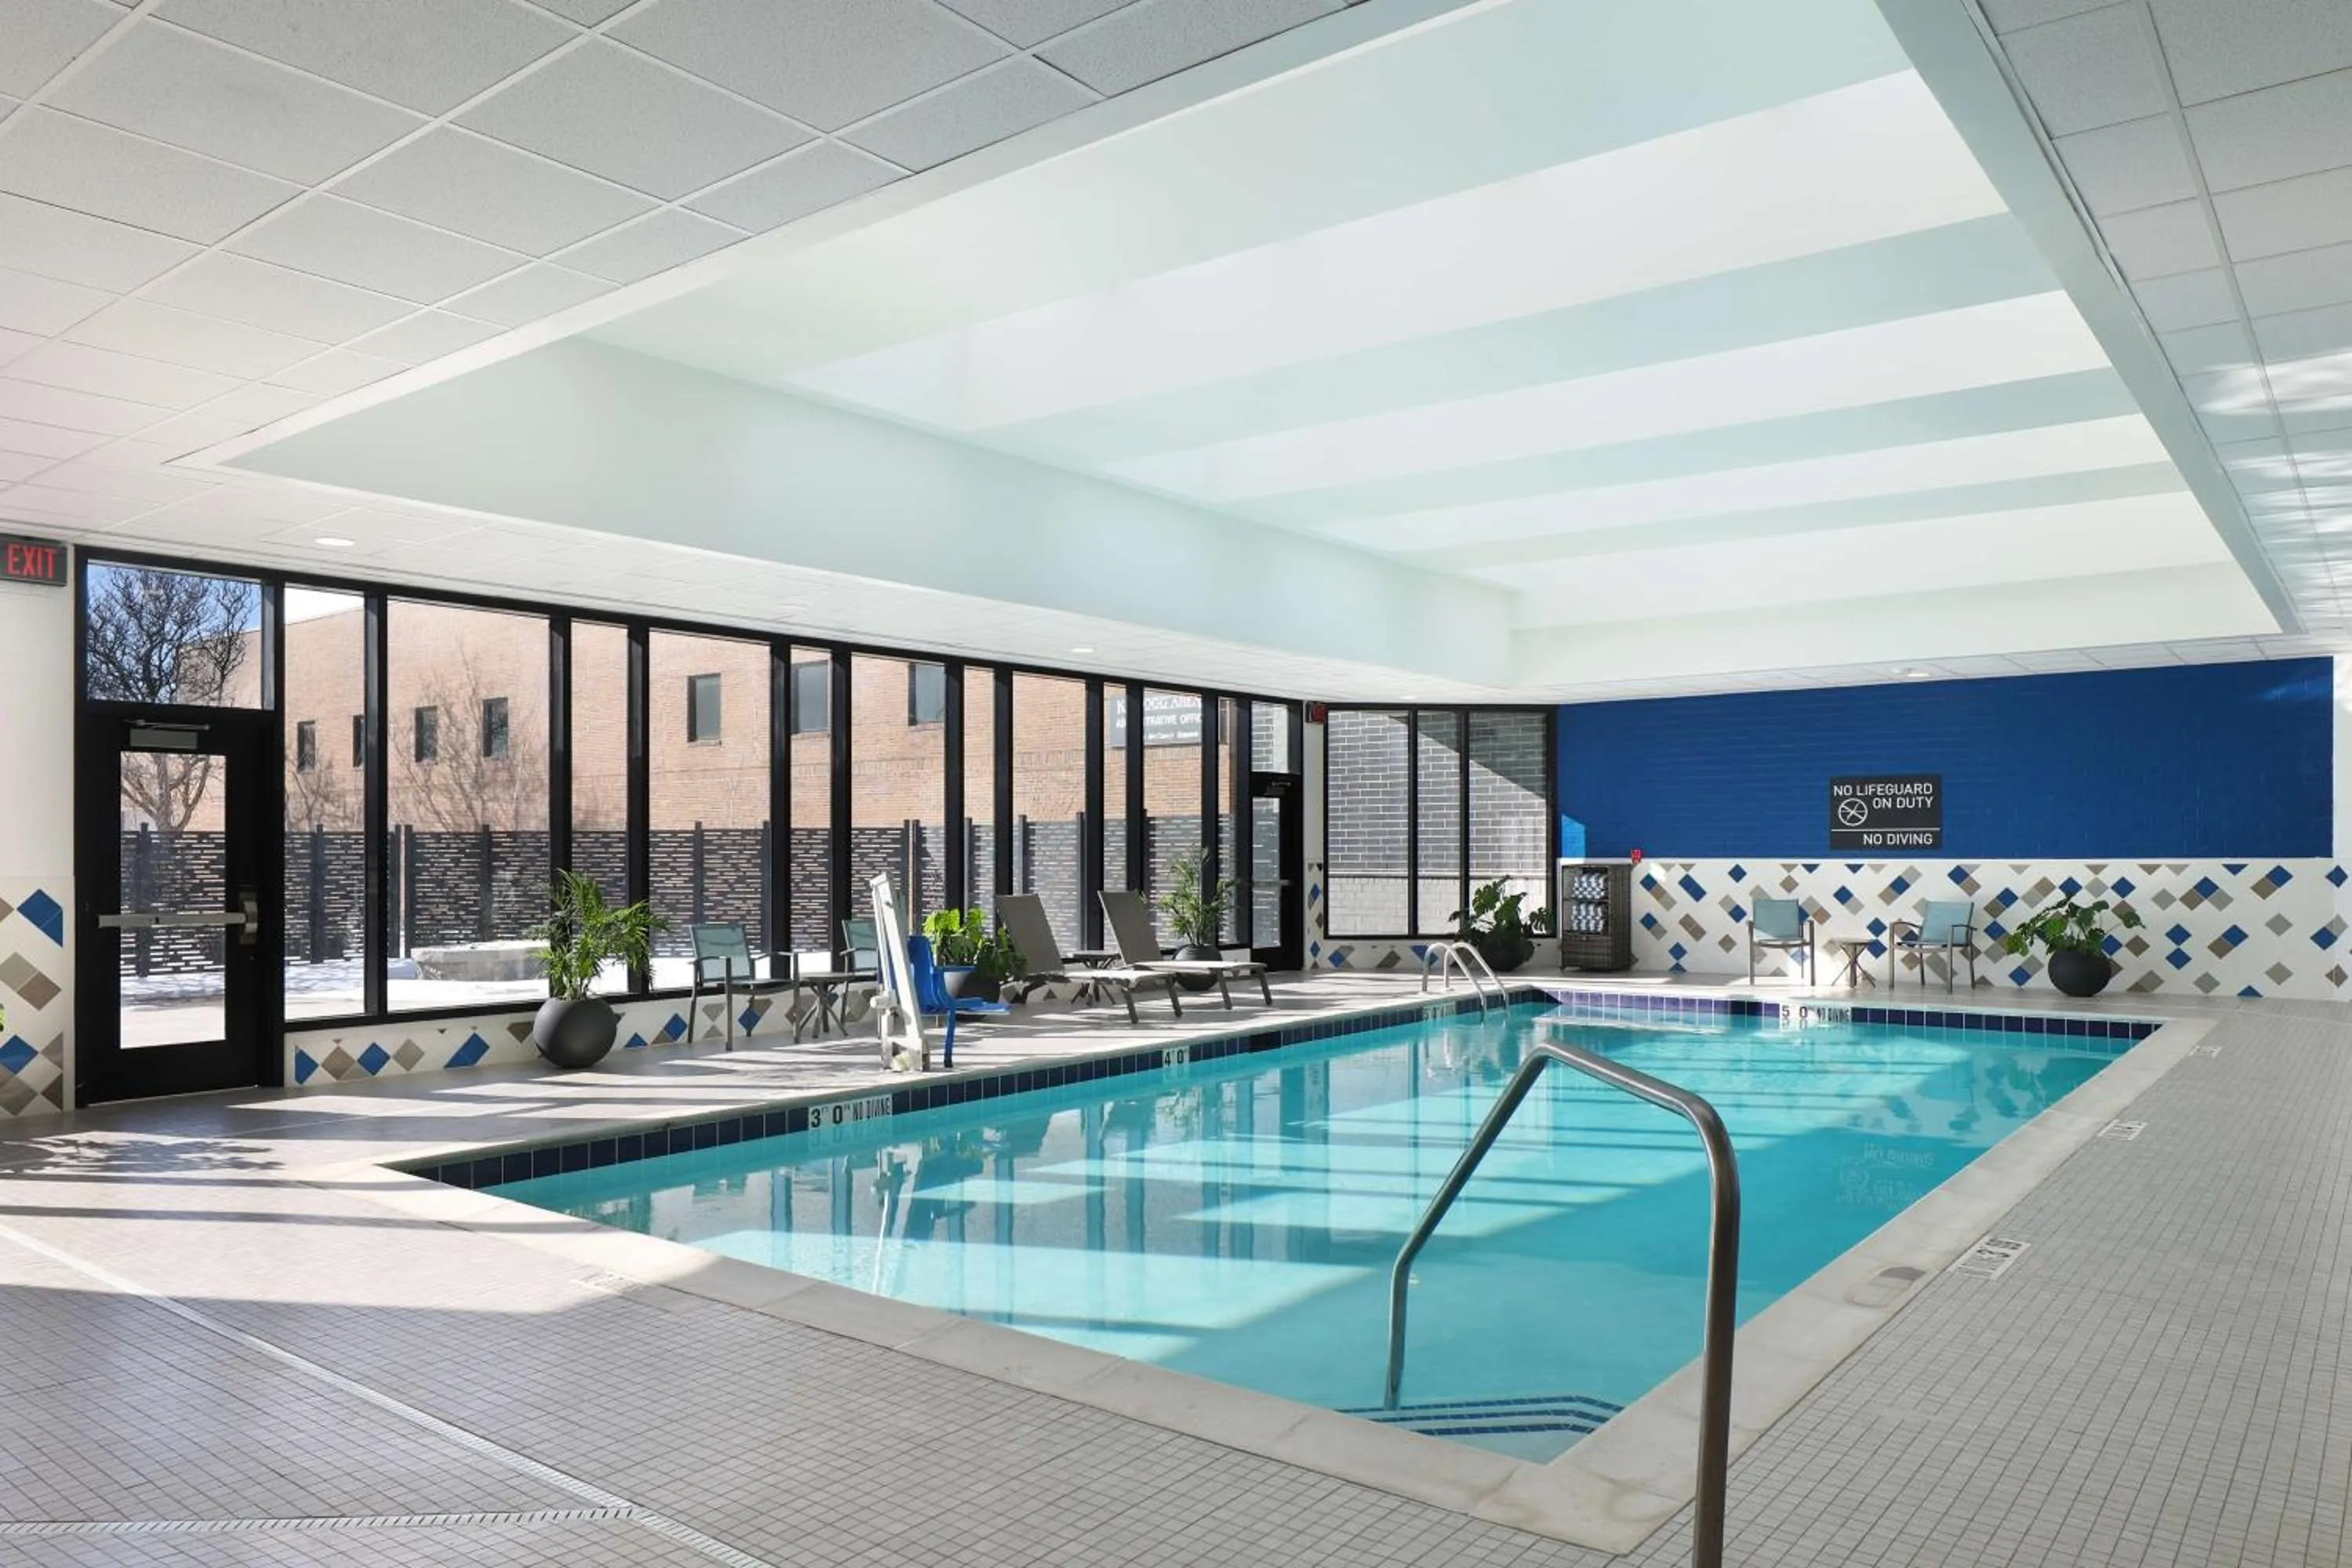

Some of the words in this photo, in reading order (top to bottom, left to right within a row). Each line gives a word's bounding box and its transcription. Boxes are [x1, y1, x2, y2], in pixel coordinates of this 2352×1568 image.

[7, 543, 56, 579] EXIT
[1180, 713, 1202, 724] OFFIC
[1833, 785, 1853, 797] NO
[1856, 782, 1933, 796] LIFEGUARD
[1872, 797, 1892, 809] ON
[1896, 797, 1934, 808] DUTY
[1863, 833, 1882, 845] NO
[1886, 833, 1933, 845] DIVING
[1781, 1004, 1790, 1018] 5
[1799, 1006, 1808, 1018] 0
[1164, 1051, 1171, 1066] 4
[811, 1108, 821, 1128] 3
[833, 1105, 844, 1125] 0
